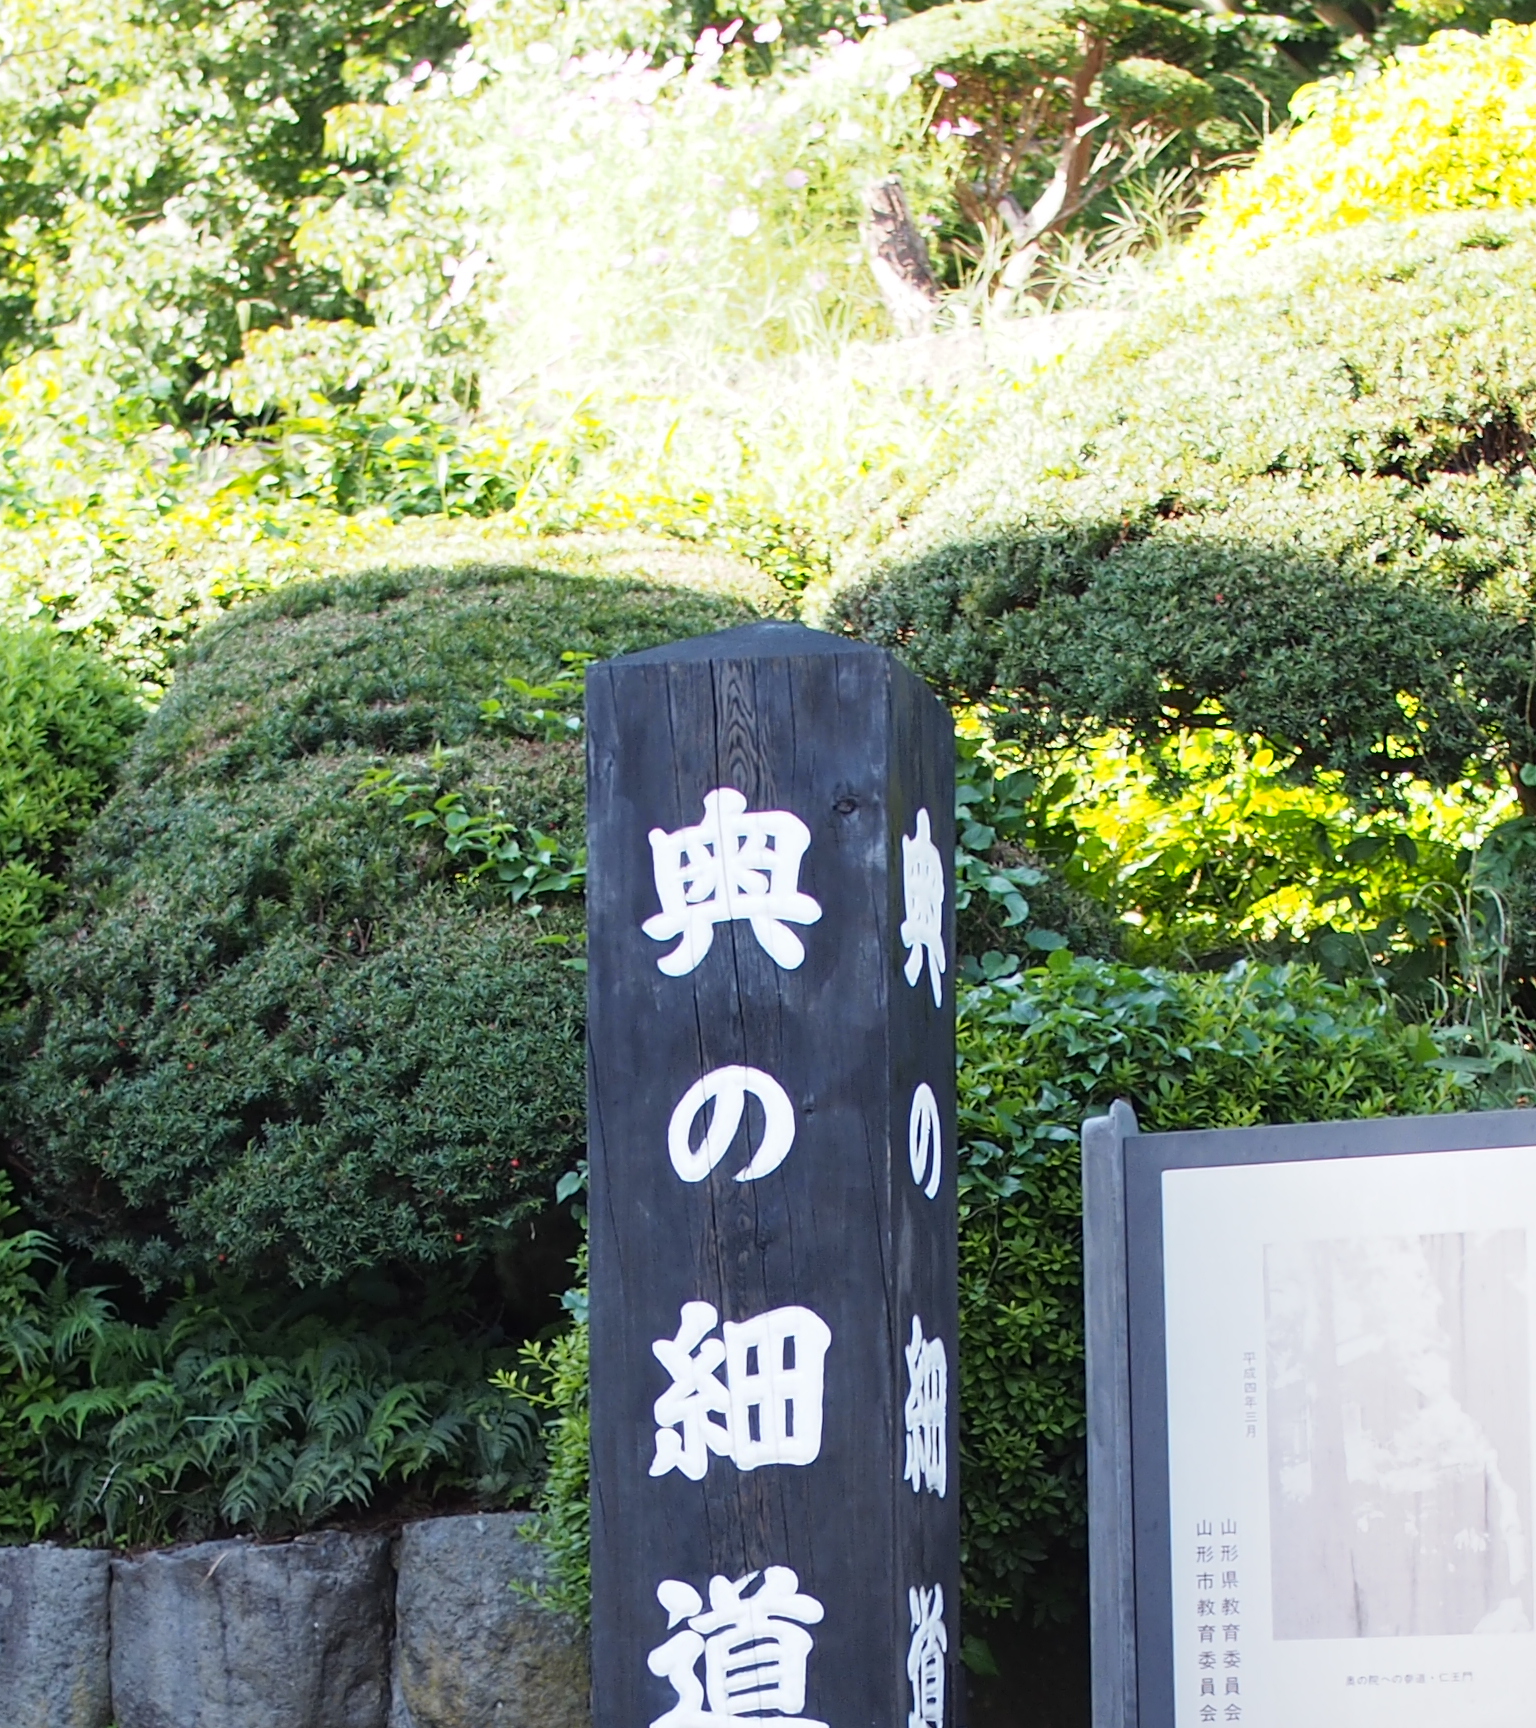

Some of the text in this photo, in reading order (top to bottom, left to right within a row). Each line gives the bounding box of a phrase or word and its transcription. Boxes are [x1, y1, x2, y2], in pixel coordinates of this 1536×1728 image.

[1241, 1351, 1259, 1439] 平成四年三月
[1195, 1519, 1218, 1722] 山形市教育委員会
[1220, 1518, 1242, 1722] 山形県教育委員会
